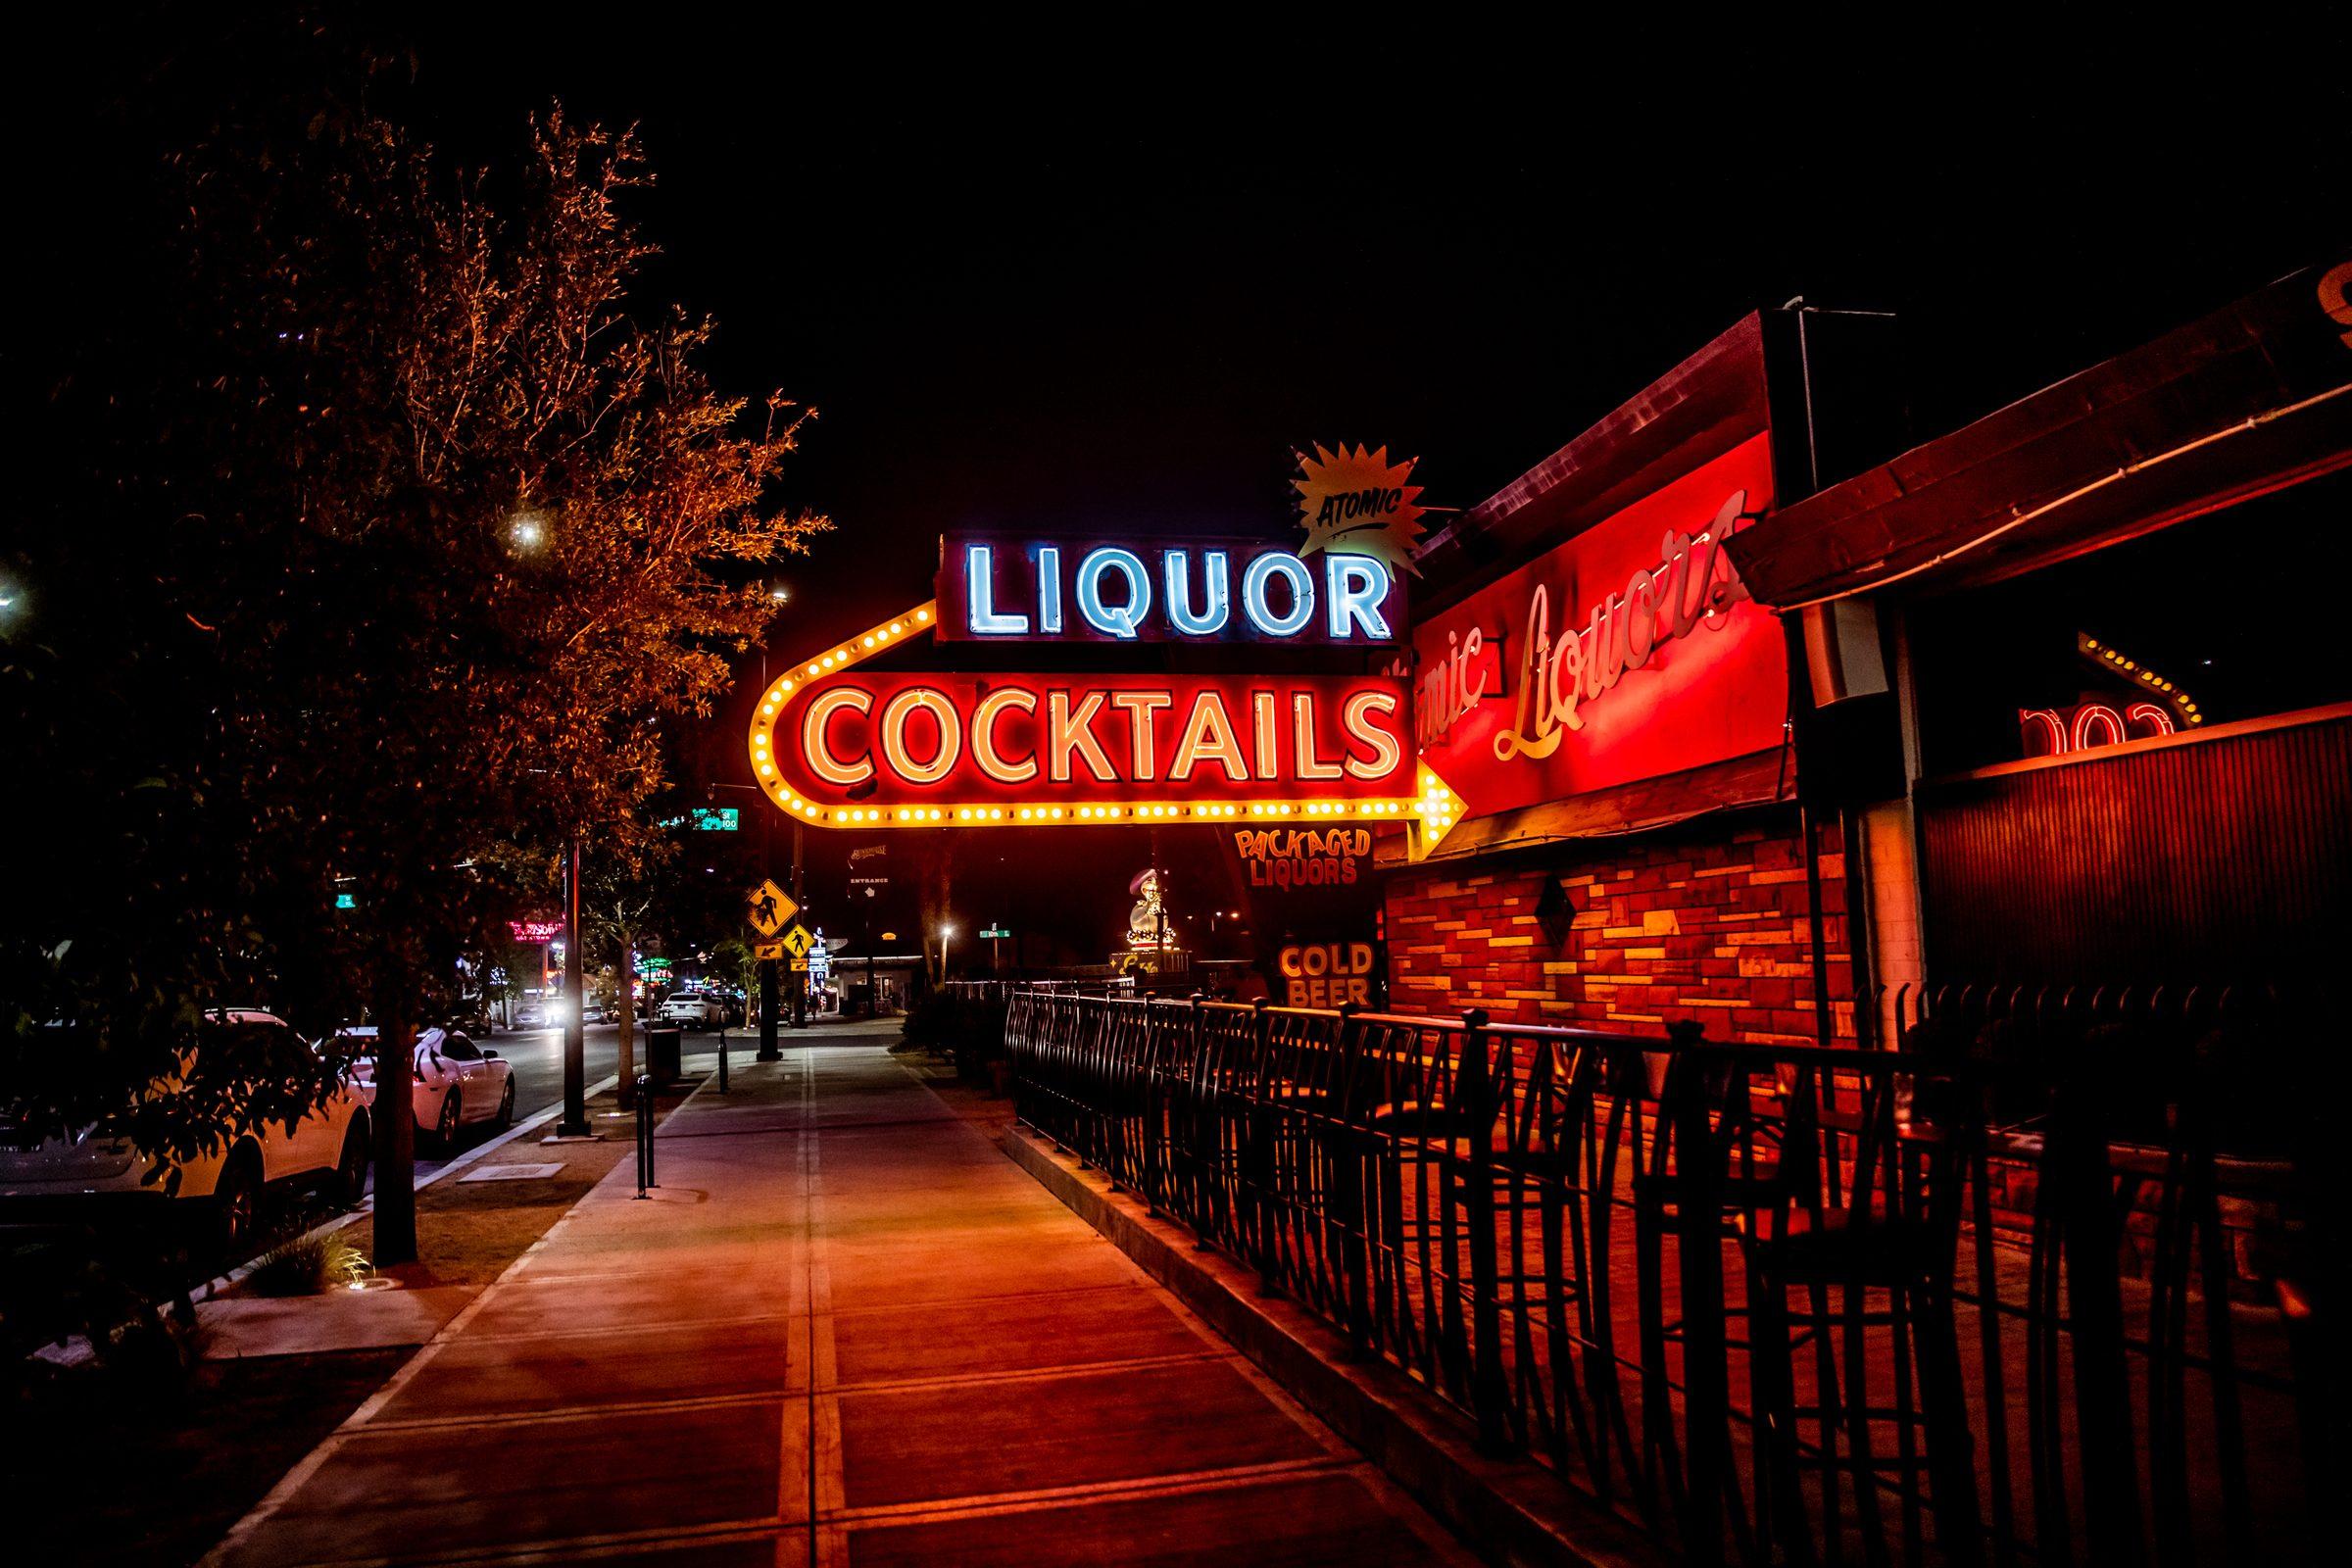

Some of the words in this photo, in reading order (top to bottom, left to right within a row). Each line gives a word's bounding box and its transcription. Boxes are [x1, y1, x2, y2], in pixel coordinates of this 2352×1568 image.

[1316, 487, 1402, 527] ATOMIC
[966, 545, 1392, 639] LIQUOR
[801, 685, 1402, 785] COCKTAILS
[1234, 827, 1371, 862] PACKAGED
[1250, 857, 1358, 893] LIQUORS
[1280, 942, 1375, 978] COLD
[1288, 978, 1372, 1009] BEER
